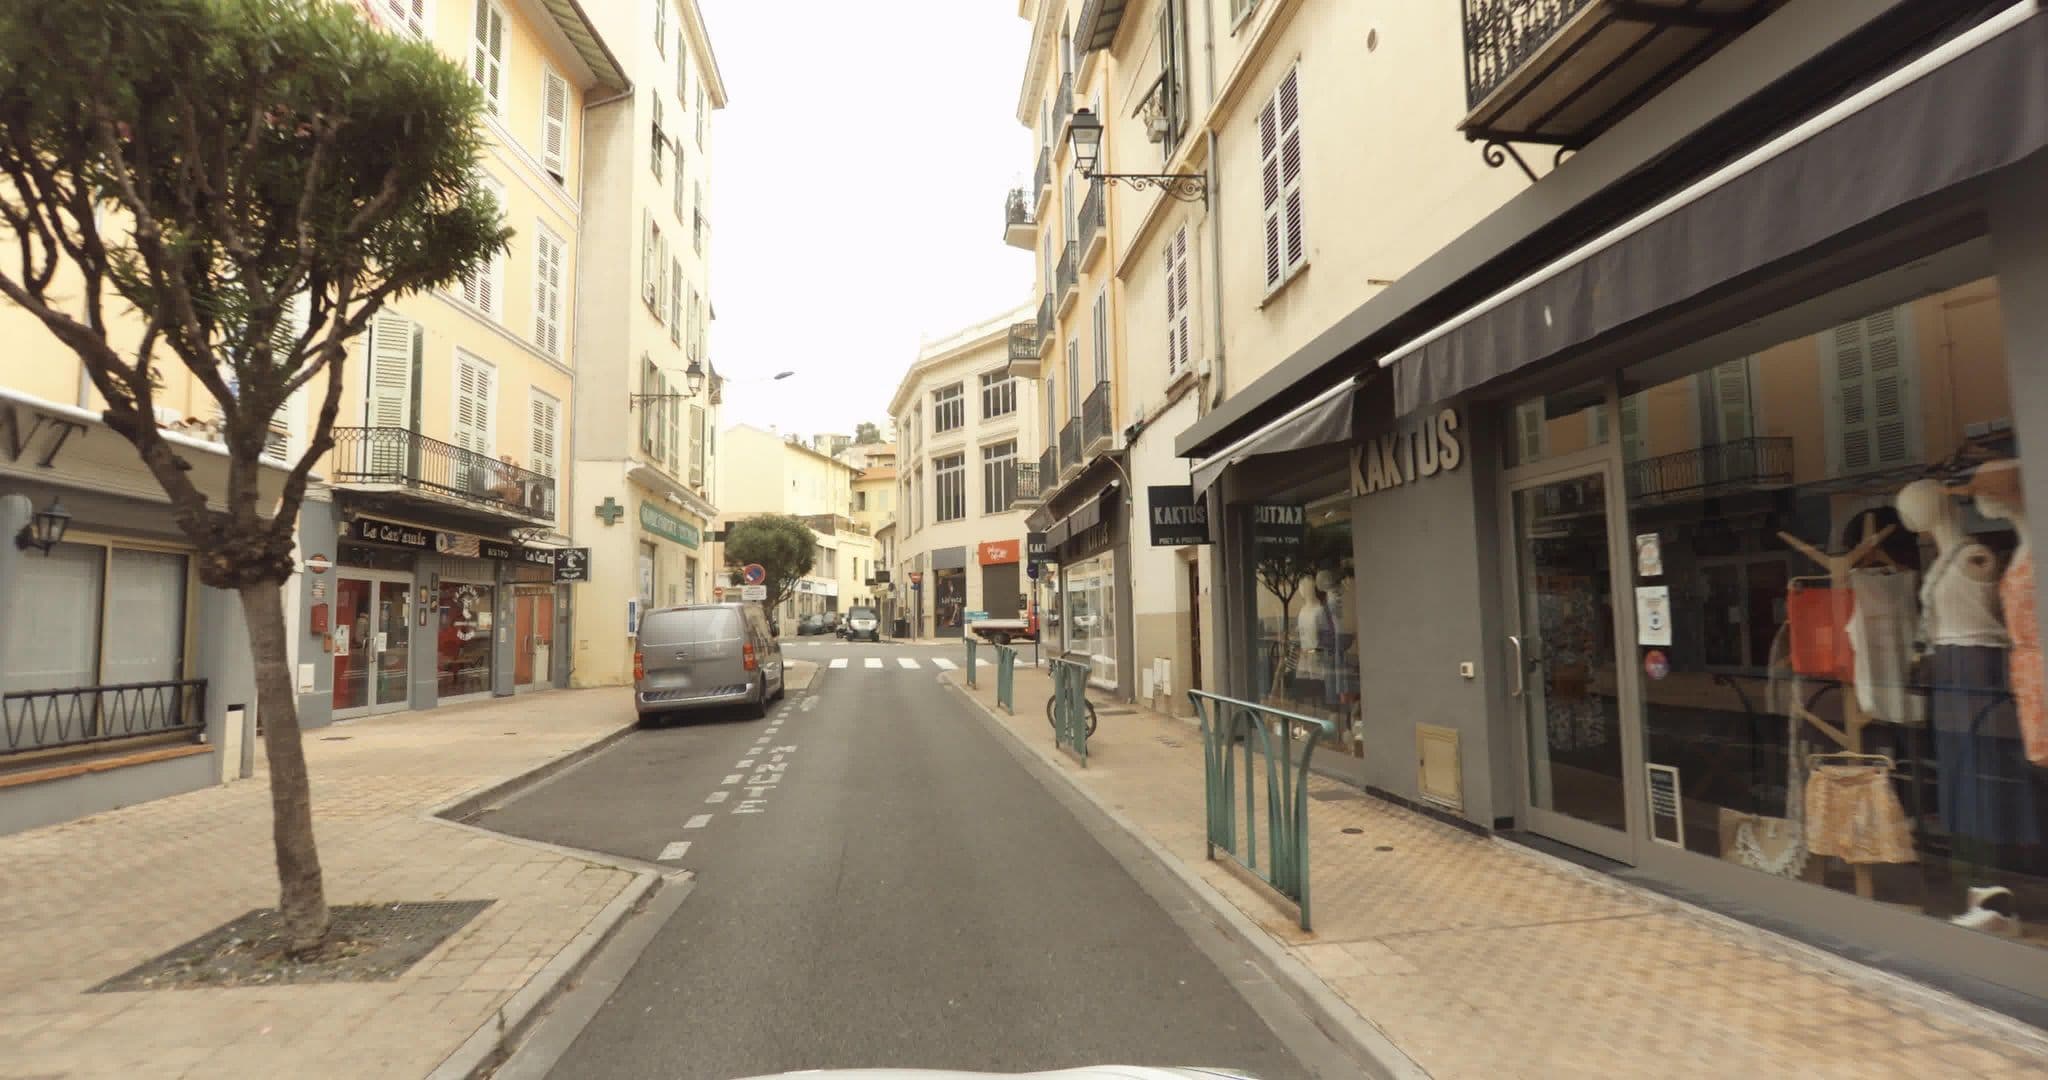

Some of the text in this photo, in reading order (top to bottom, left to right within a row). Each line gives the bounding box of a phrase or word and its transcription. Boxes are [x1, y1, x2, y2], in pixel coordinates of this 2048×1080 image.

[1350, 408, 1460, 497] KAKTUS
[1154, 506, 1206, 525] KAKTUS
[1029, 543, 1047, 553] KAKT
